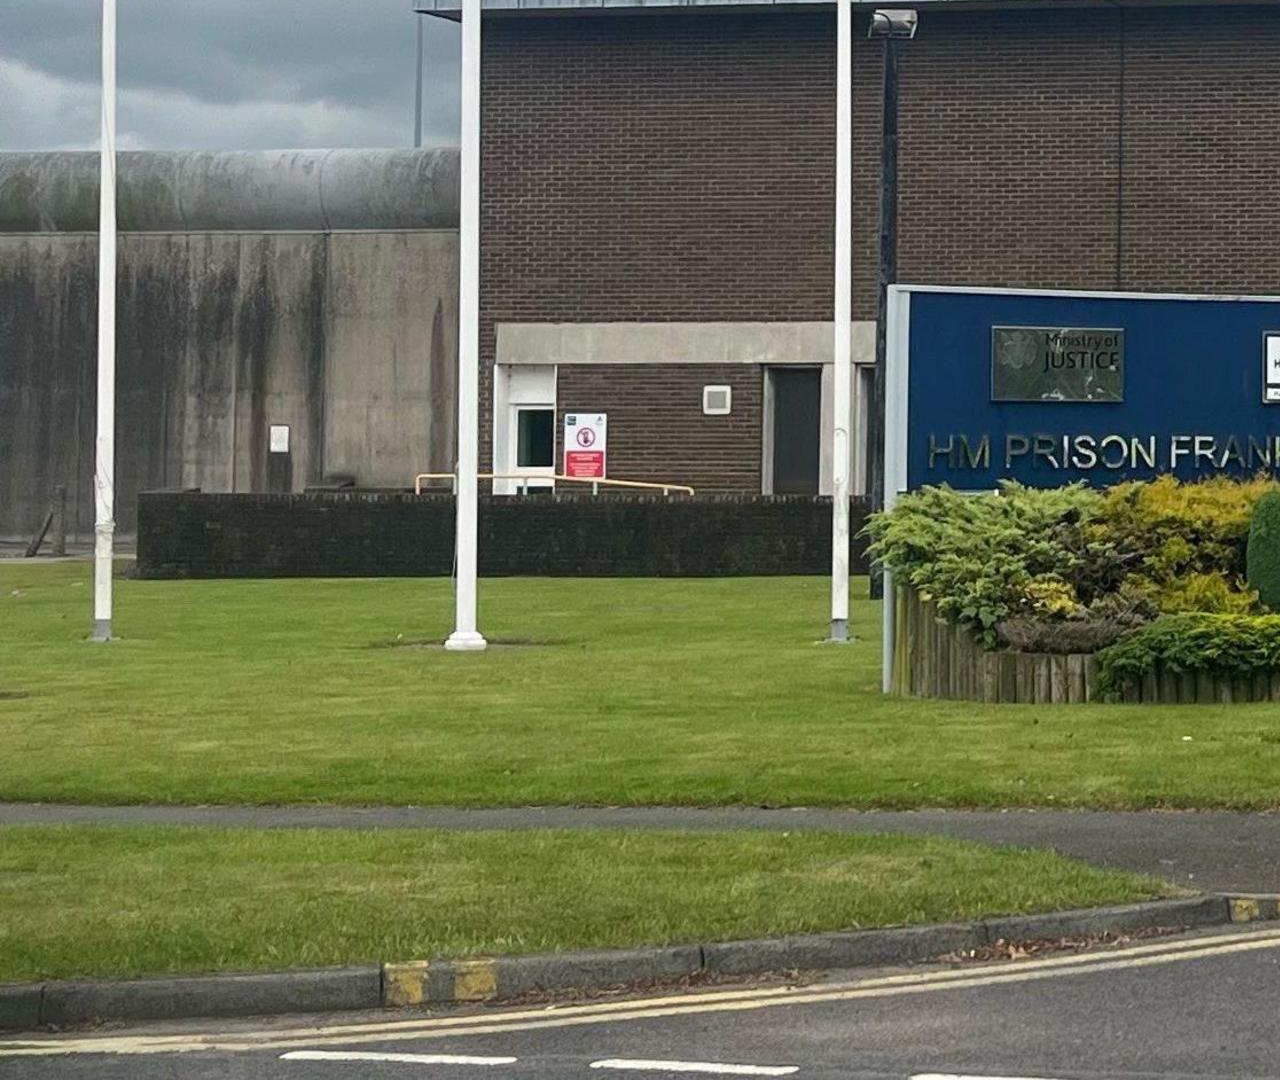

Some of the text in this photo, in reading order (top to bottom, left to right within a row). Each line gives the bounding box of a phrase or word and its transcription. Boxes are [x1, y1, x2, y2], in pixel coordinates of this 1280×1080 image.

[1045, 333, 1118, 350] Ministry of
[1043, 351, 1119, 372] JUSTICE
[929, 433, 990, 469] HM
[1005, 434, 1156, 469] PRISON
